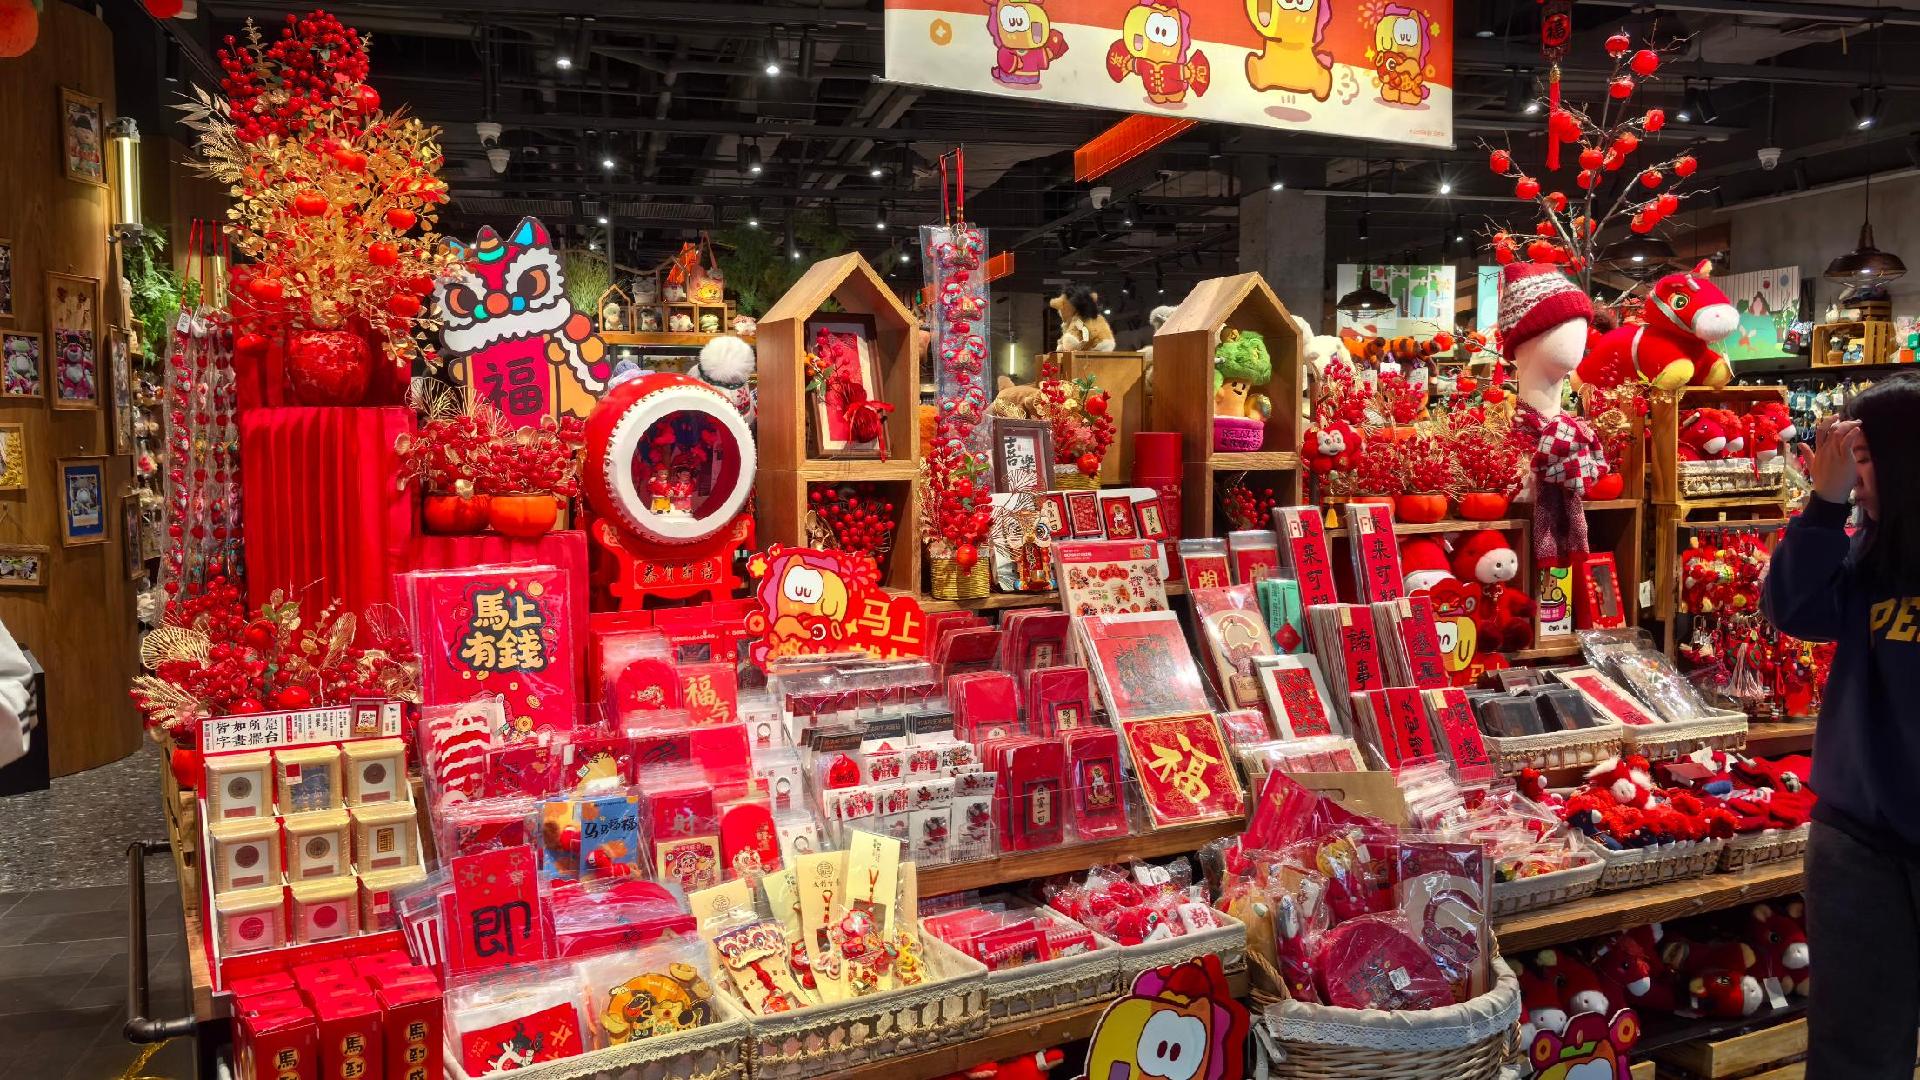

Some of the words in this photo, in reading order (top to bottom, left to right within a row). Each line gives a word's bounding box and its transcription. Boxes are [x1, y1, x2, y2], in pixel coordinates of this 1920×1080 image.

[483, 357, 543, 415] 福
[473, 590, 541, 631] 馬上
[858, 598, 920, 644] 马上
[1870, 597, 1920, 642] PE
[462, 628, 544, 668] 有錢
[1149, 733, 1219, 804] 福
